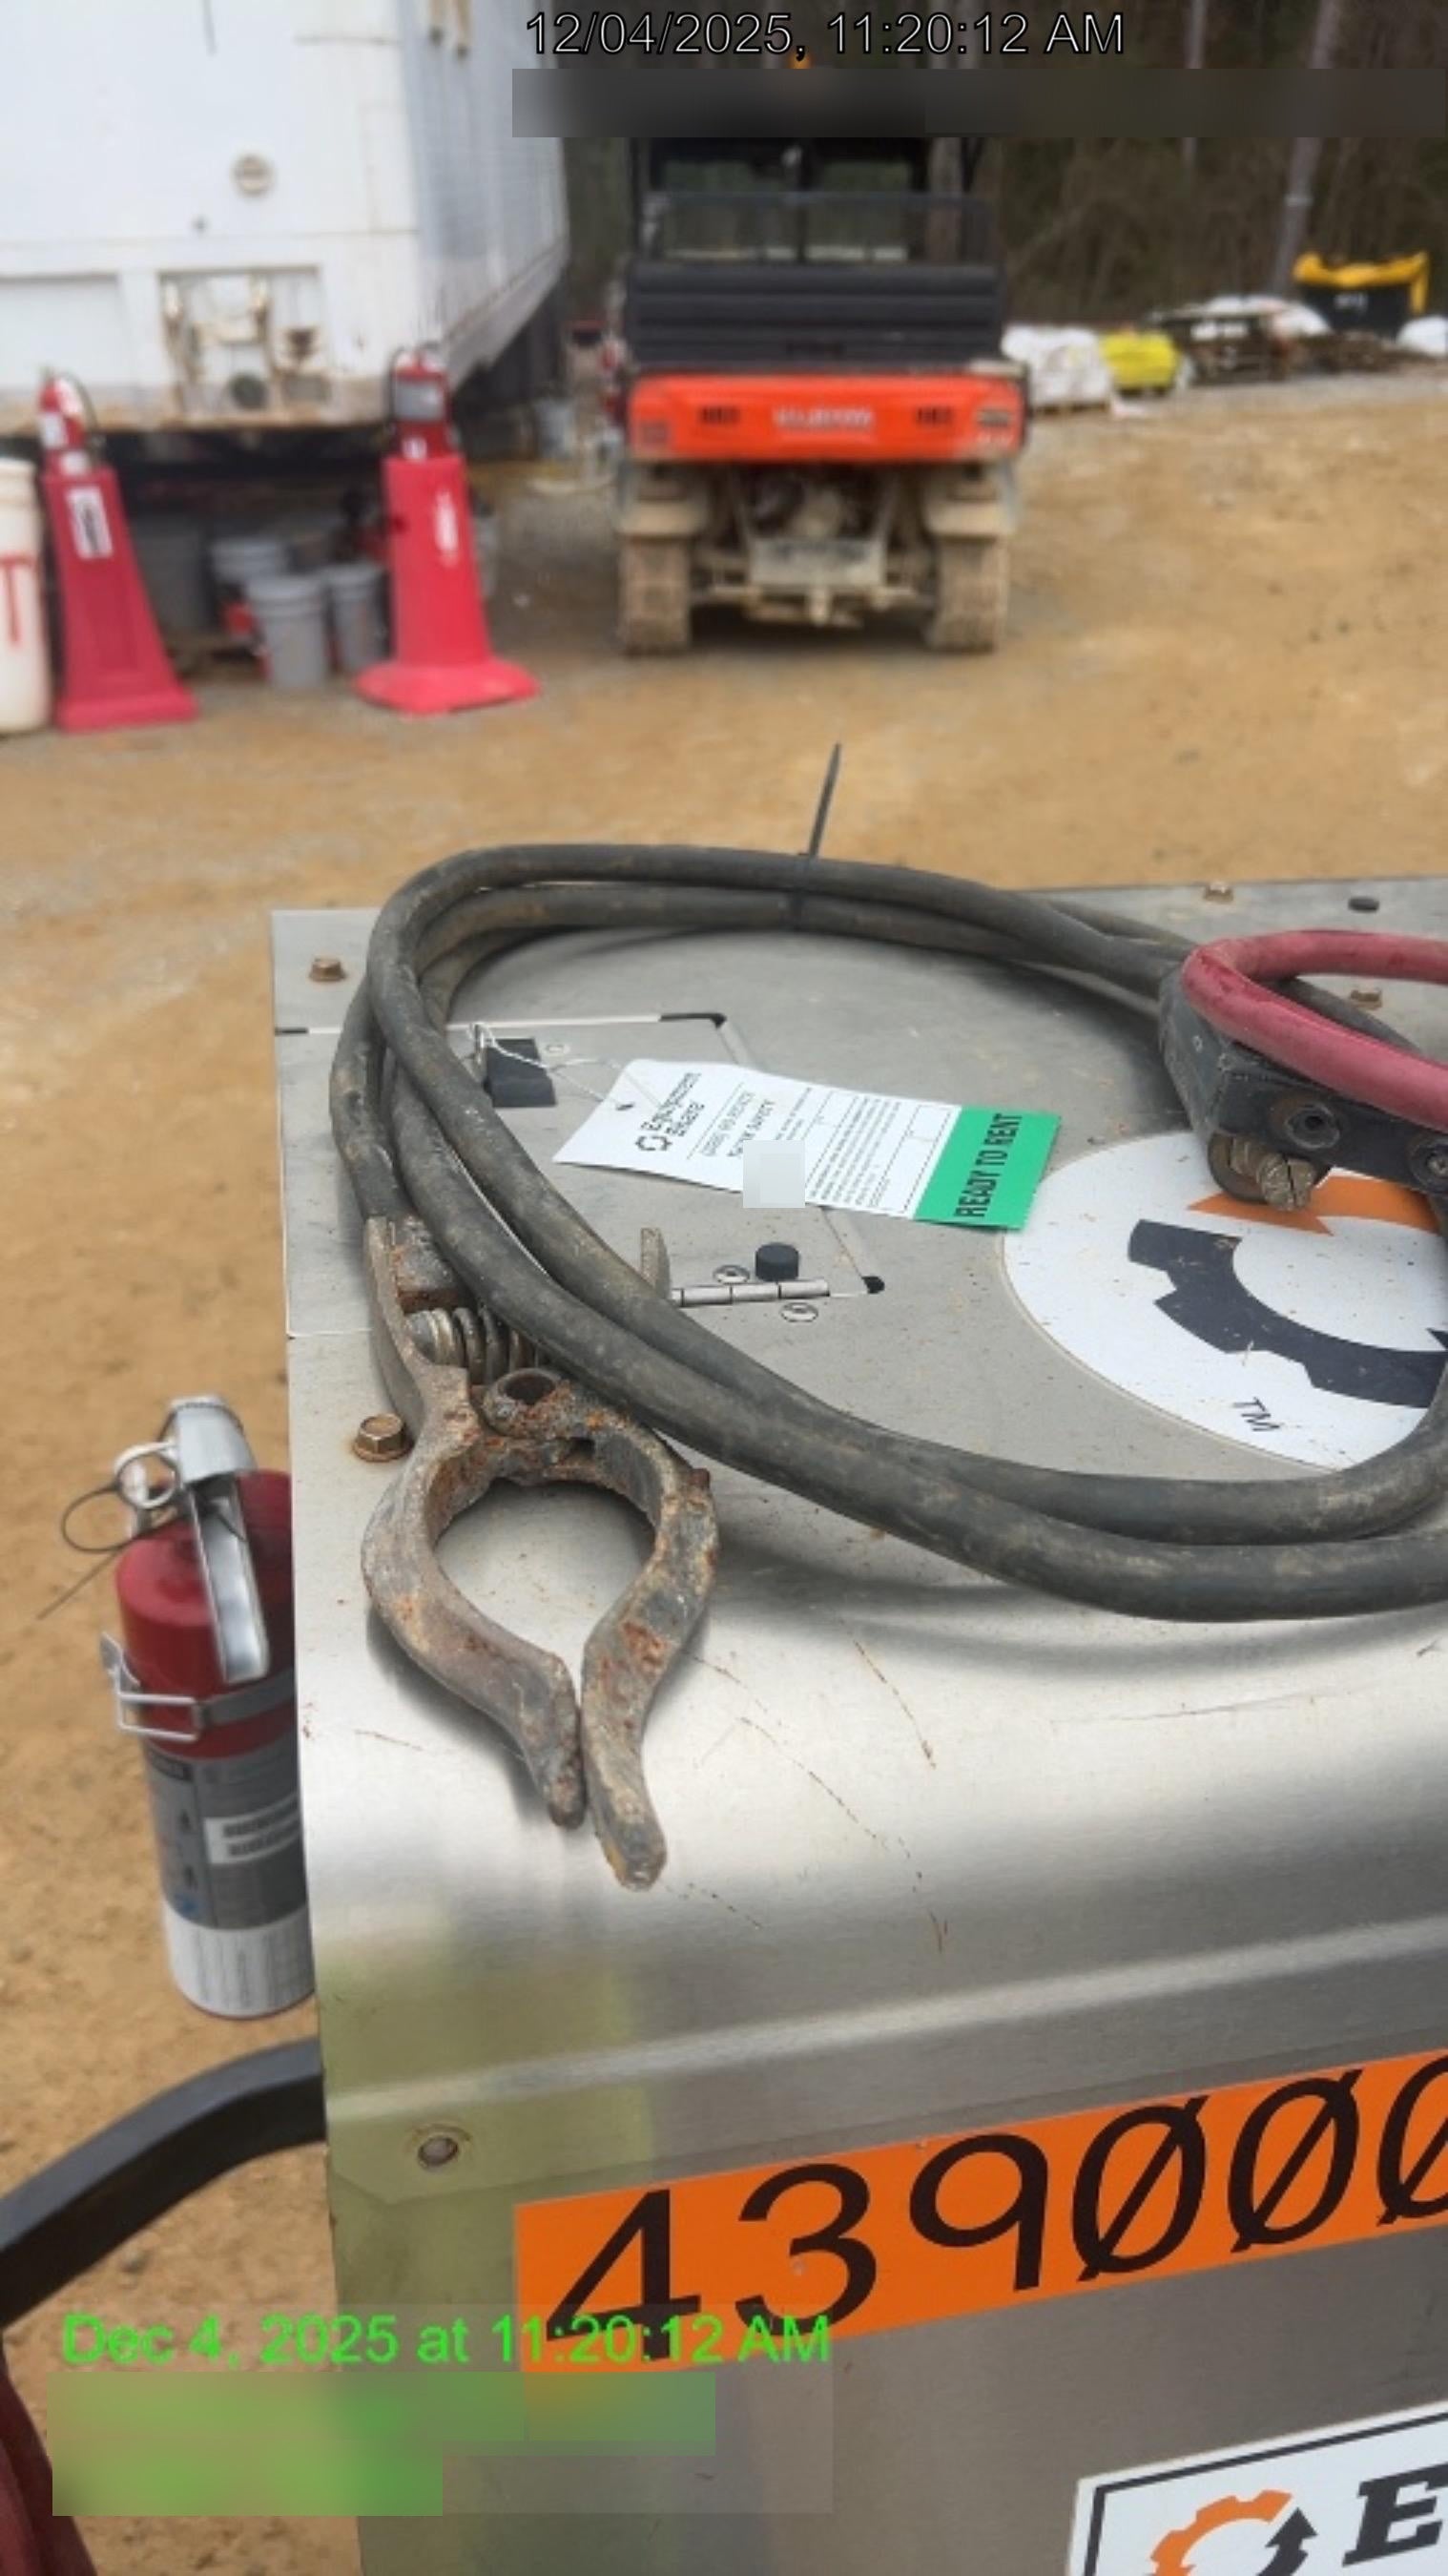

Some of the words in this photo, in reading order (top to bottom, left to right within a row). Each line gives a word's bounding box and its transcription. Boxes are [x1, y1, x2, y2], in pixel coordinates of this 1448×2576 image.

[983, 1112, 1024, 1145] RENT
[975, 1149, 1009, 1167] TO
[954, 1170, 1002, 1217] READY
[1232, 1396, 1281, 1432] TM
